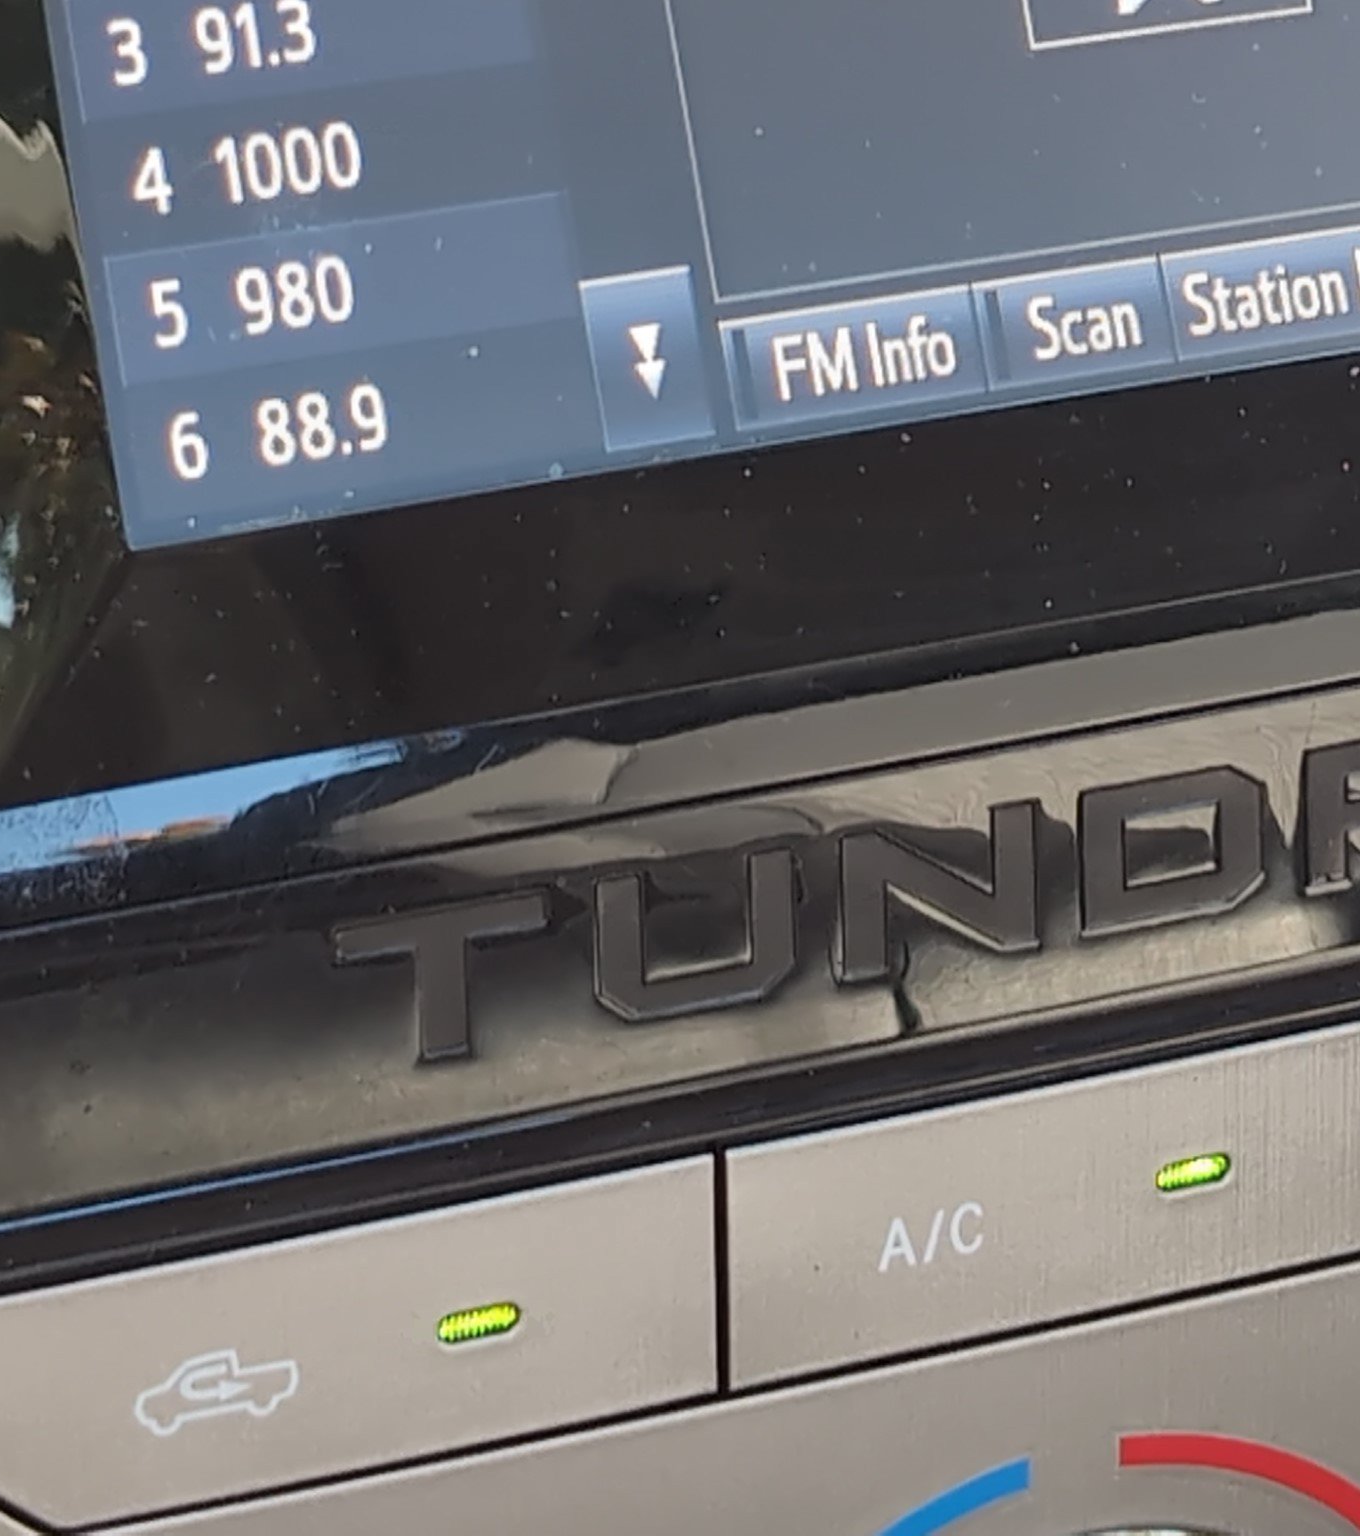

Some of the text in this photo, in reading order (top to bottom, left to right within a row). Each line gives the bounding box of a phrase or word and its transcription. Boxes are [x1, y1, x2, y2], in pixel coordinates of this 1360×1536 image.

[106, 17, 148, 87] 3
[132, 121, 362, 215] 4 1000
[149, 255, 356, 348] 5 980
[1026, 295, 1143, 360] Scan
[1181, 265, 1349, 336] Station
[771, 314, 957, 402] FM Info
[169, 384, 389, 480] 6 88.9
[877, 1200, 984, 1272] A/C
